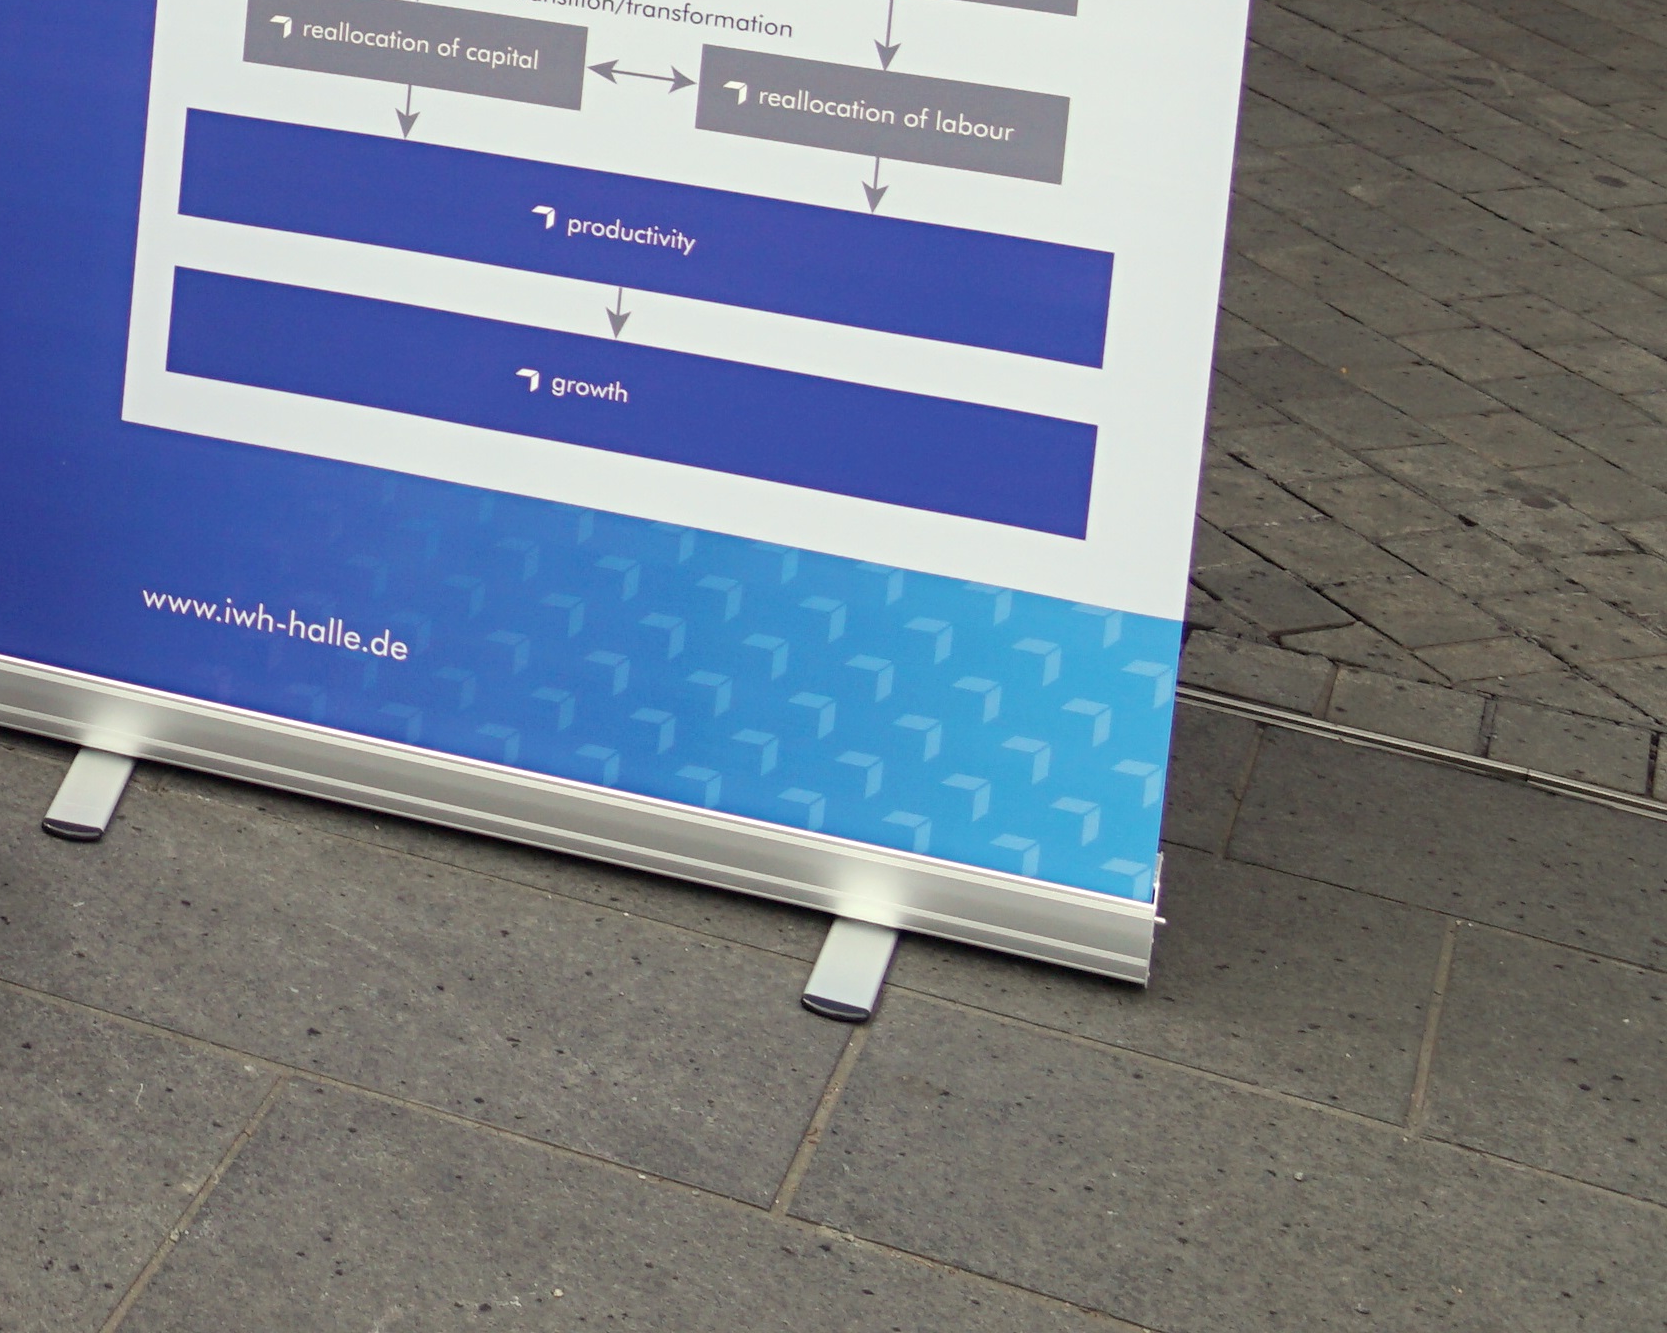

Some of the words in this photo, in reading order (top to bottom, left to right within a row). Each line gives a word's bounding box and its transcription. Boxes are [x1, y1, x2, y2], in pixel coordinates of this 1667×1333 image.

[303, 21, 429, 53] reallocation
[438, 38, 460, 57] of
[466, 47, 538, 69] capital
[759, 90, 894, 124] reallocation
[904, 108, 929, 128] of
[936, 110, 1015, 141] labour
[568, 219, 696, 255] productivity
[552, 378, 628, 402] growth
[143, 590, 407, 660] www.iwh-halle.de
